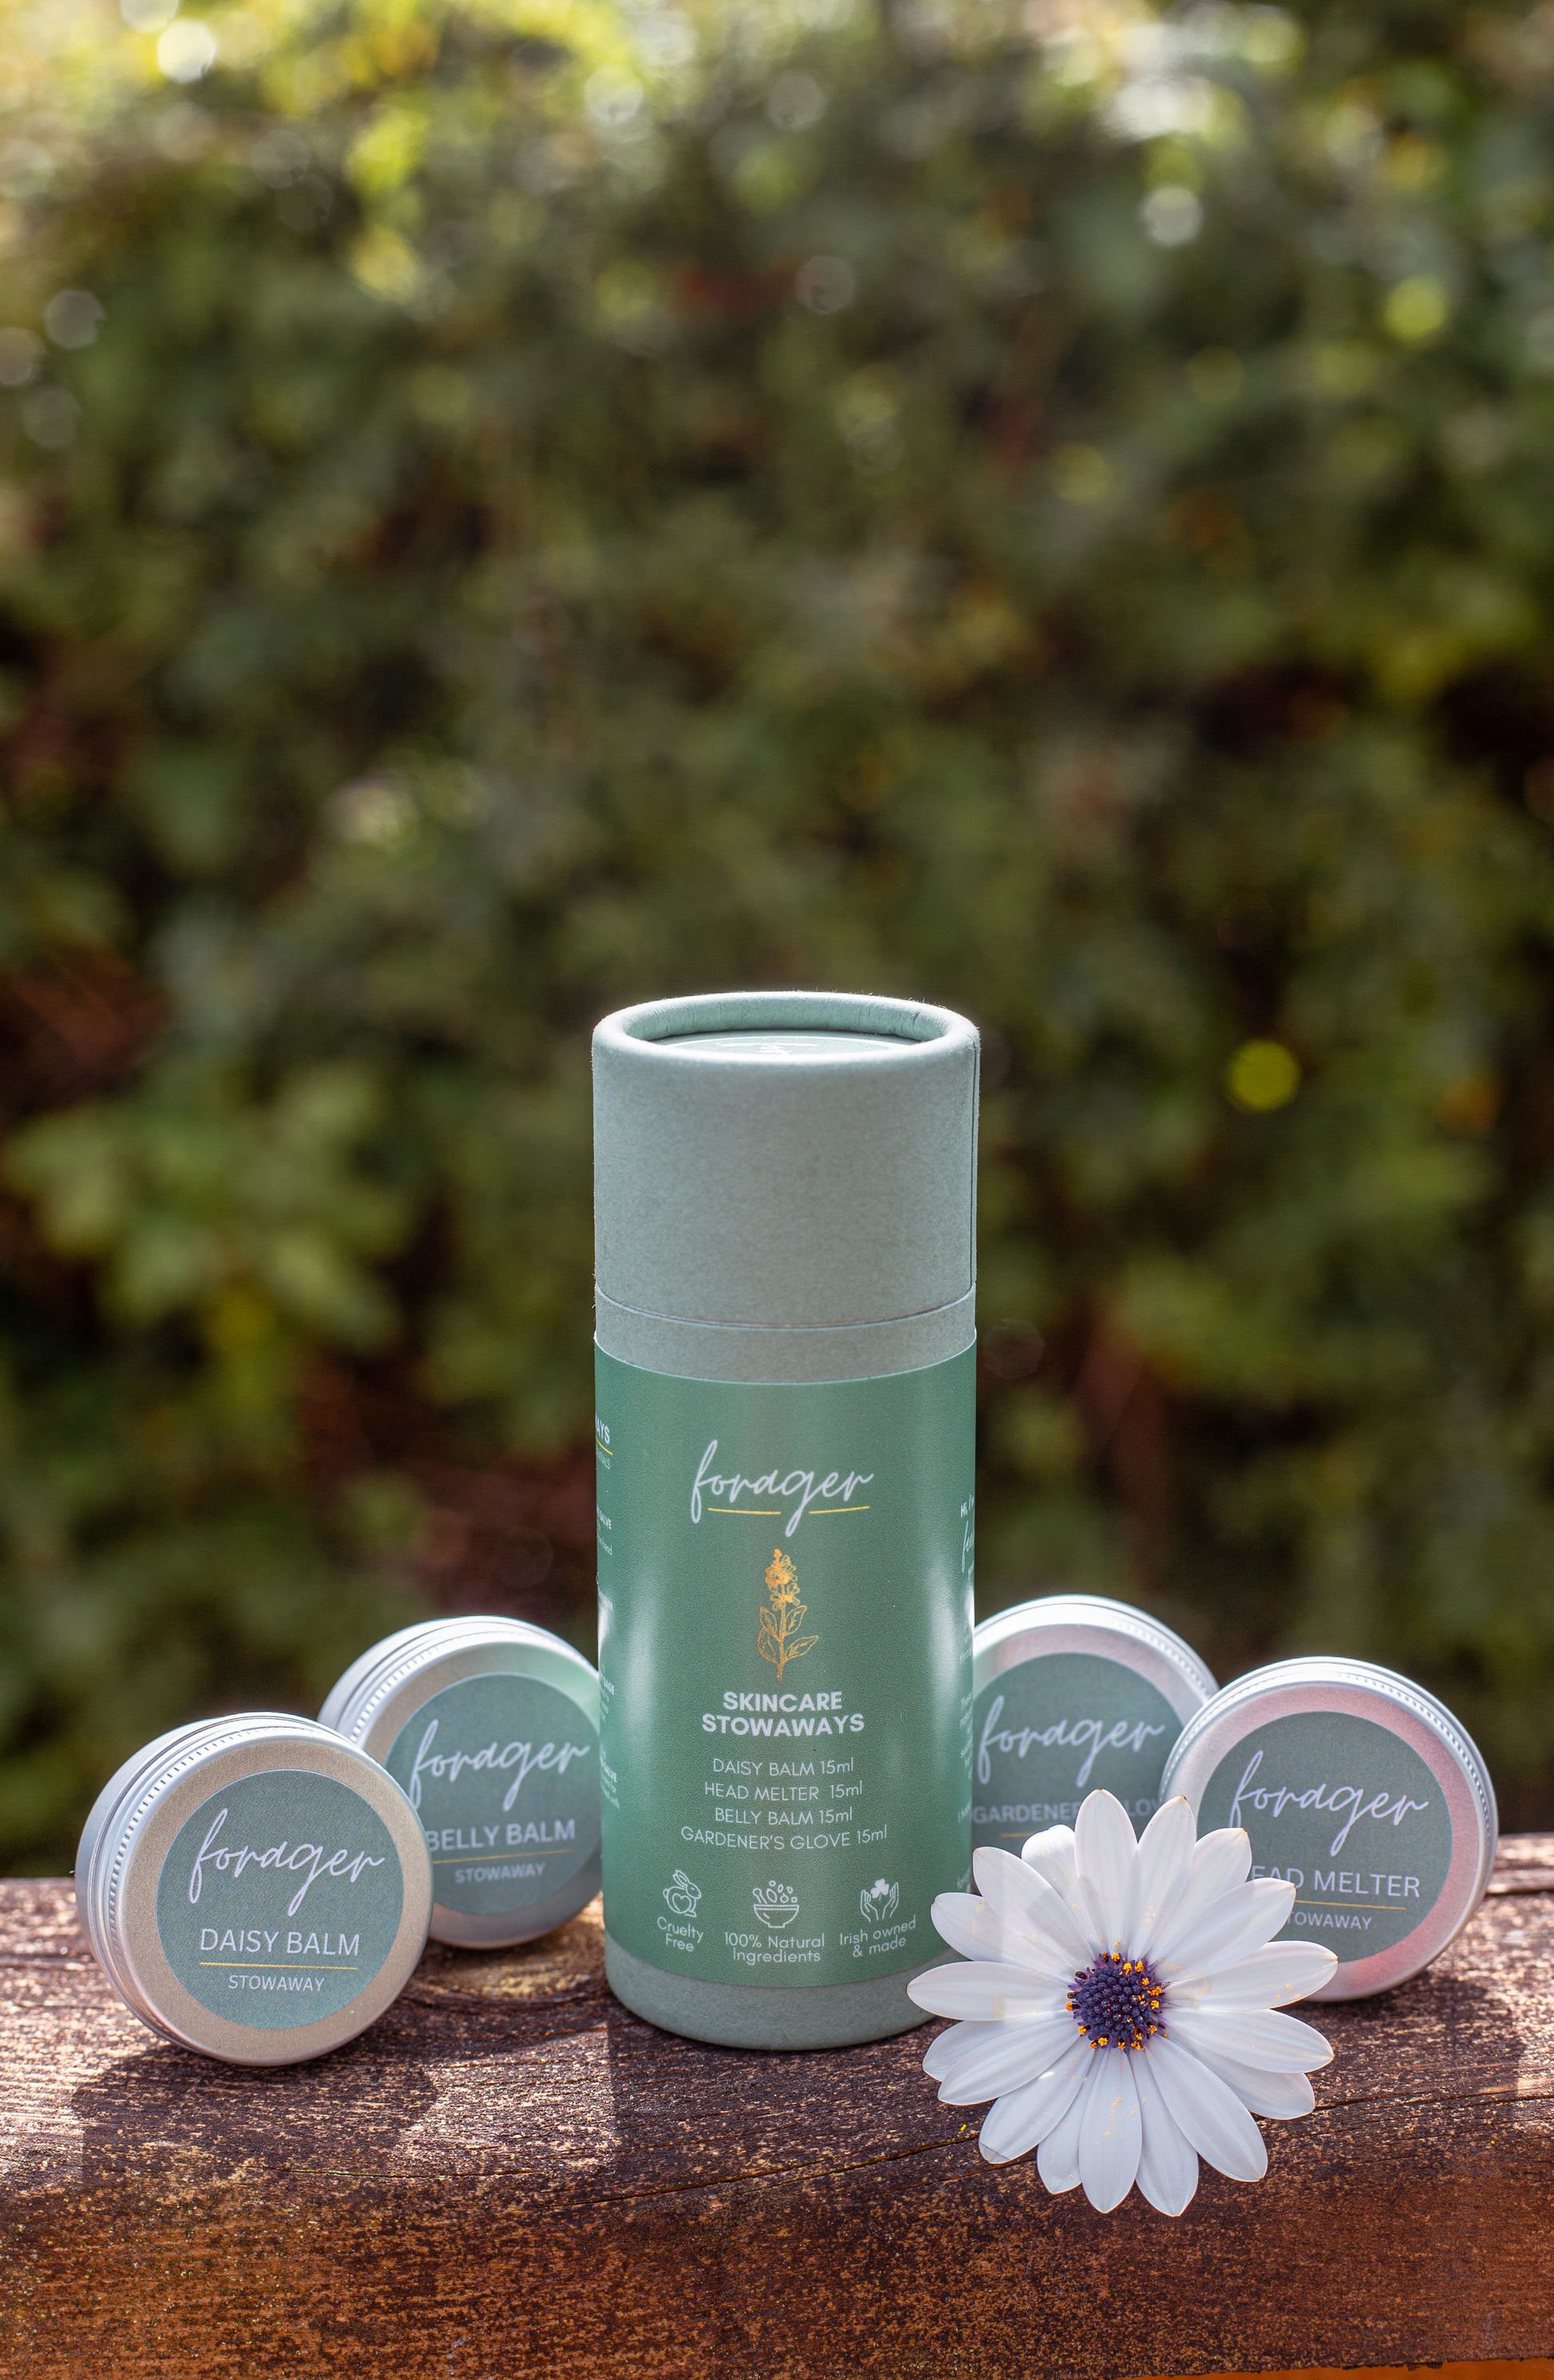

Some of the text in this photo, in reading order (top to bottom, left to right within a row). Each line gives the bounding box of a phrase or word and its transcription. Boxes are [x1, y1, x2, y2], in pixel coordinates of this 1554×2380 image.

[691, 1439, 874, 1537] forager
[723, 1691, 842, 1712] SKINCARE
[702, 1713, 864, 1736] STOWAWAYS
[977, 1694, 1166, 1788] forager
[409, 1719, 591, 1812] forager
[713, 1757, 854, 1776] DAISY BALM 15ml
[705, 1780, 862, 1801] HEAD MELTER 15ml
[1229, 1750, 1429, 1856] forager
[716, 1807, 852, 1825] BELLY BALM 15ml
[426, 1819, 575, 1851] BELLY BALM
[681, 1824, 887, 1850] GARDENER'S GLOVE 15ml
[189, 1808, 385, 1916] forager
[454, 1862, 546, 1884] STOWAWAY
[1251, 1865, 1420, 1897] EAD MELTER
[657, 1917, 704, 1943] Cruelty
[839, 1915, 916, 1946] Irish owned
[1286, 1911, 1372, 1930] TOWAWAY
[200, 1928, 359, 1955] DAISY BALM
[665, 1934, 694, 1952] Free
[724, 1932, 825, 1948] 100% Natural
[852, 1934, 906, 1958] & made
[733, 1950, 821, 1966] Ingredients
[228, 1975, 324, 1991] STOWAWAY
